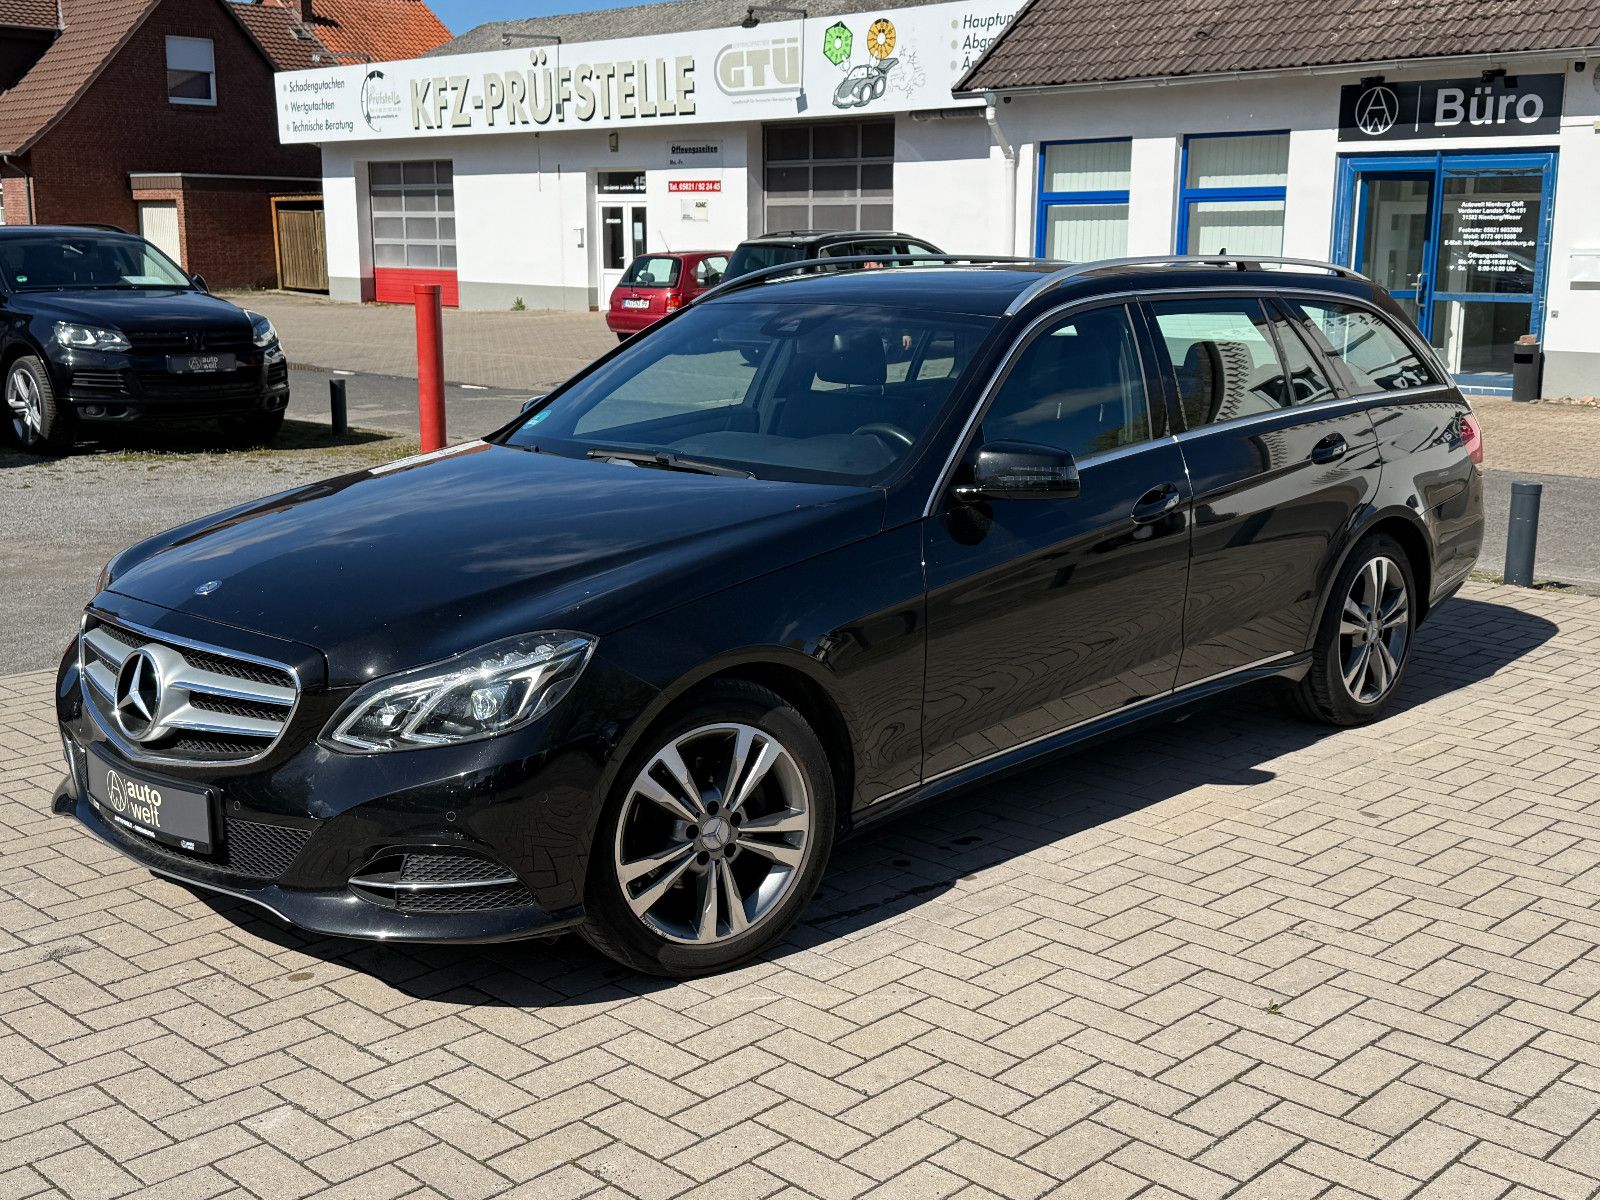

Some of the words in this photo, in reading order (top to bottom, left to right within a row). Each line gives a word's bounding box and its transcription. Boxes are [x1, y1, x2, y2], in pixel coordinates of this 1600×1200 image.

[963, 13, 1016, 31] Hauptun
[289, 77, 345, 93] Schadengutachten
[409, 48, 696, 130] KFZ-PRÜFSTELLE
[290, 98, 335, 114] Wertgutachten
[1434, 86, 1544, 127] Büro
[292, 120, 324, 132] Technische
[325, 119, 354, 132] Beratung
[126, 780, 162, 807] auto
[130, 801, 161, 828] welt
